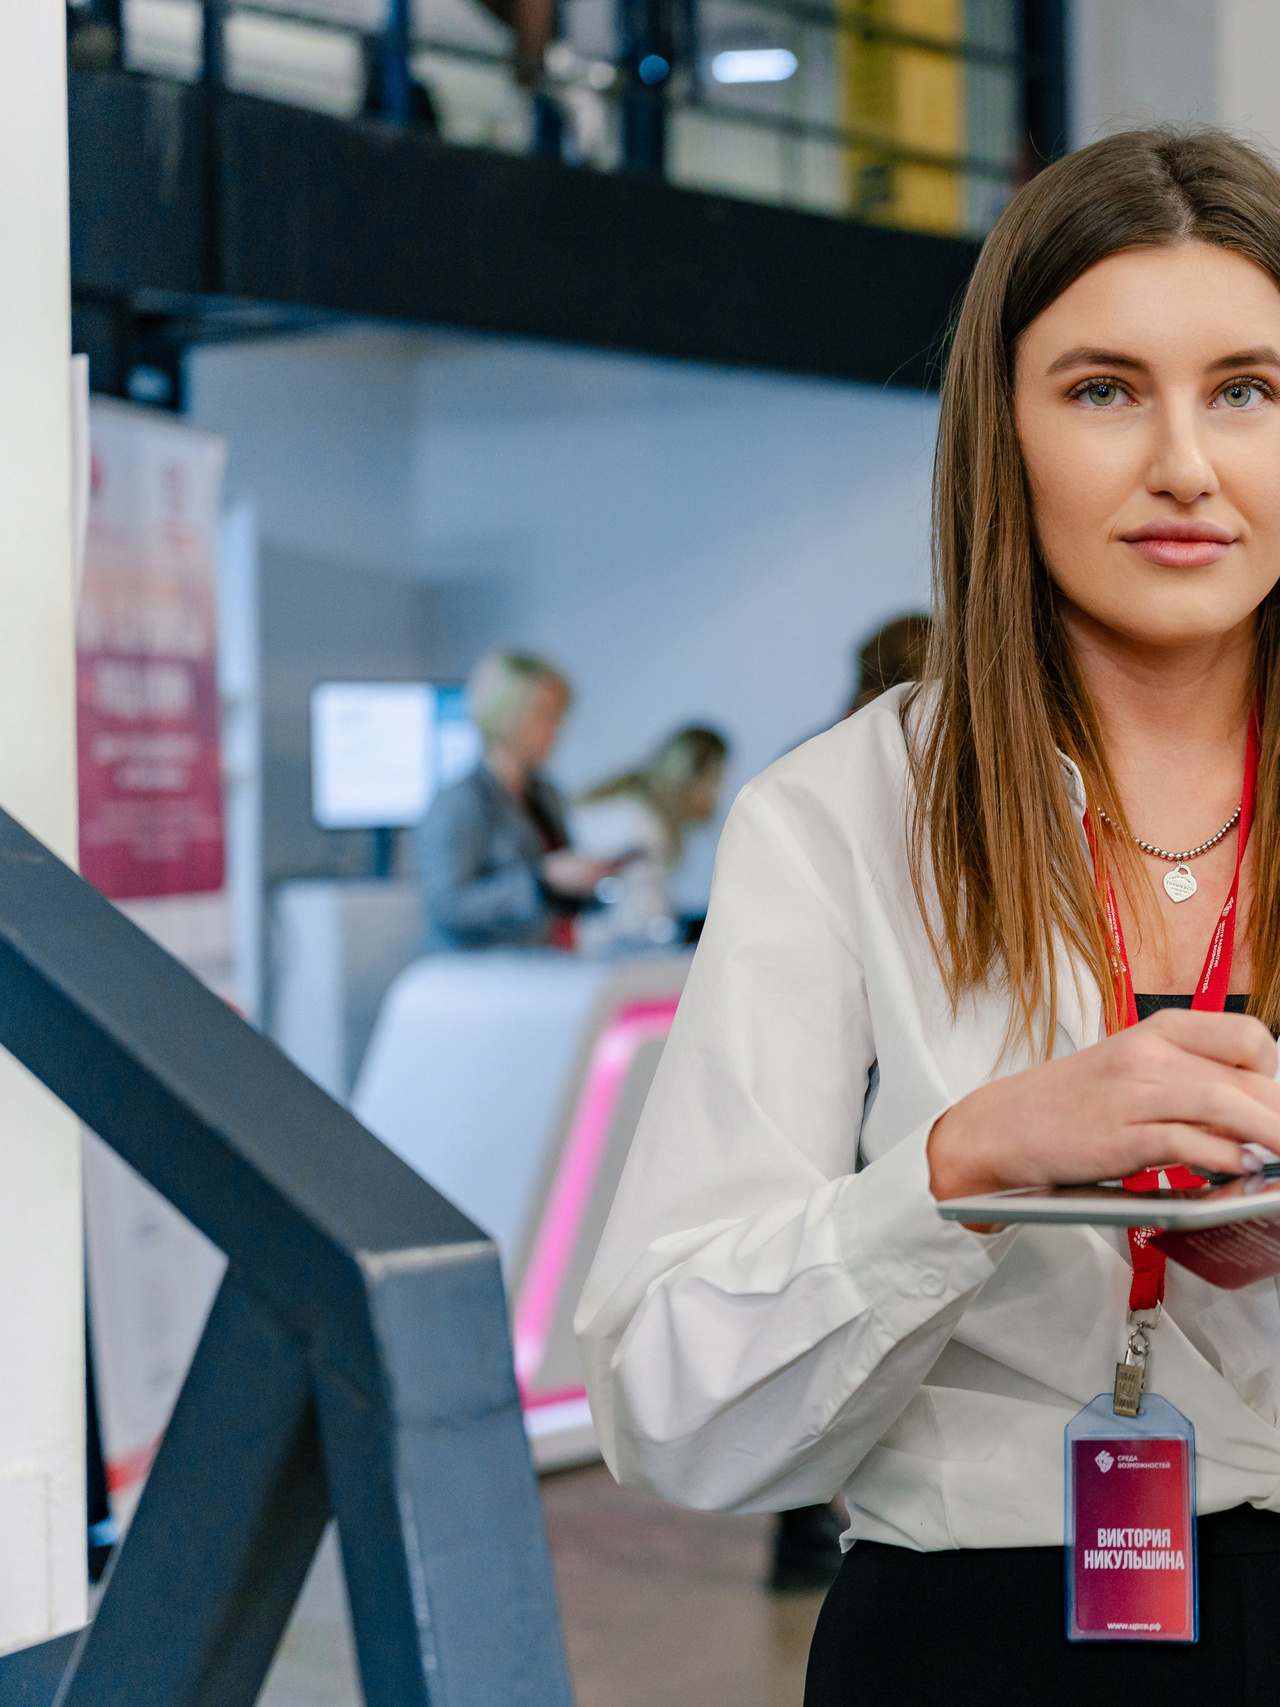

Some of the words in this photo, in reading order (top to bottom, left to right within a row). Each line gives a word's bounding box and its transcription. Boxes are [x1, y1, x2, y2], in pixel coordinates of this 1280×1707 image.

[1117, 1461, 1171, 1469] ВОЗМОЖНОСТЕЙ
[1097, 1528, 1171, 1548] ВИКТОРИЯ
[1084, 1550, 1185, 1570] НИКУЛЬШИНА
